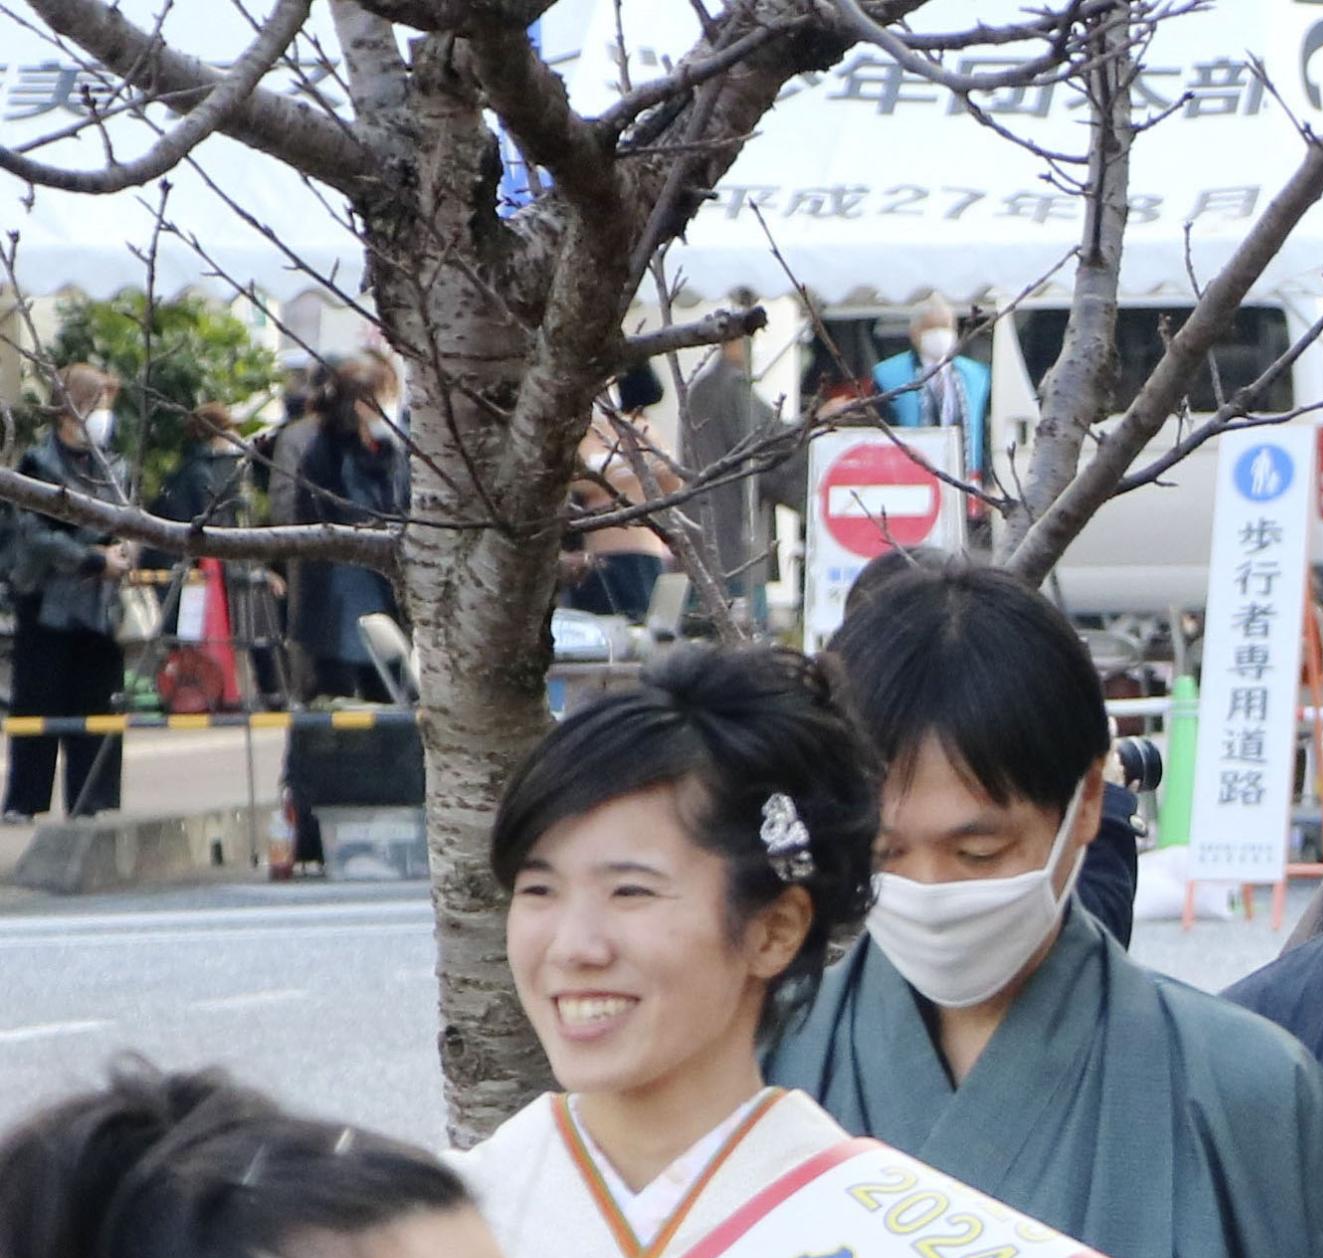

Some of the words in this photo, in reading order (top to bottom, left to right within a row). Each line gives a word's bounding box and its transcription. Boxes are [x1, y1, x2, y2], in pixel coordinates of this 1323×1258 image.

[1216, 516, 1283, 807] 歩行者専用道路
